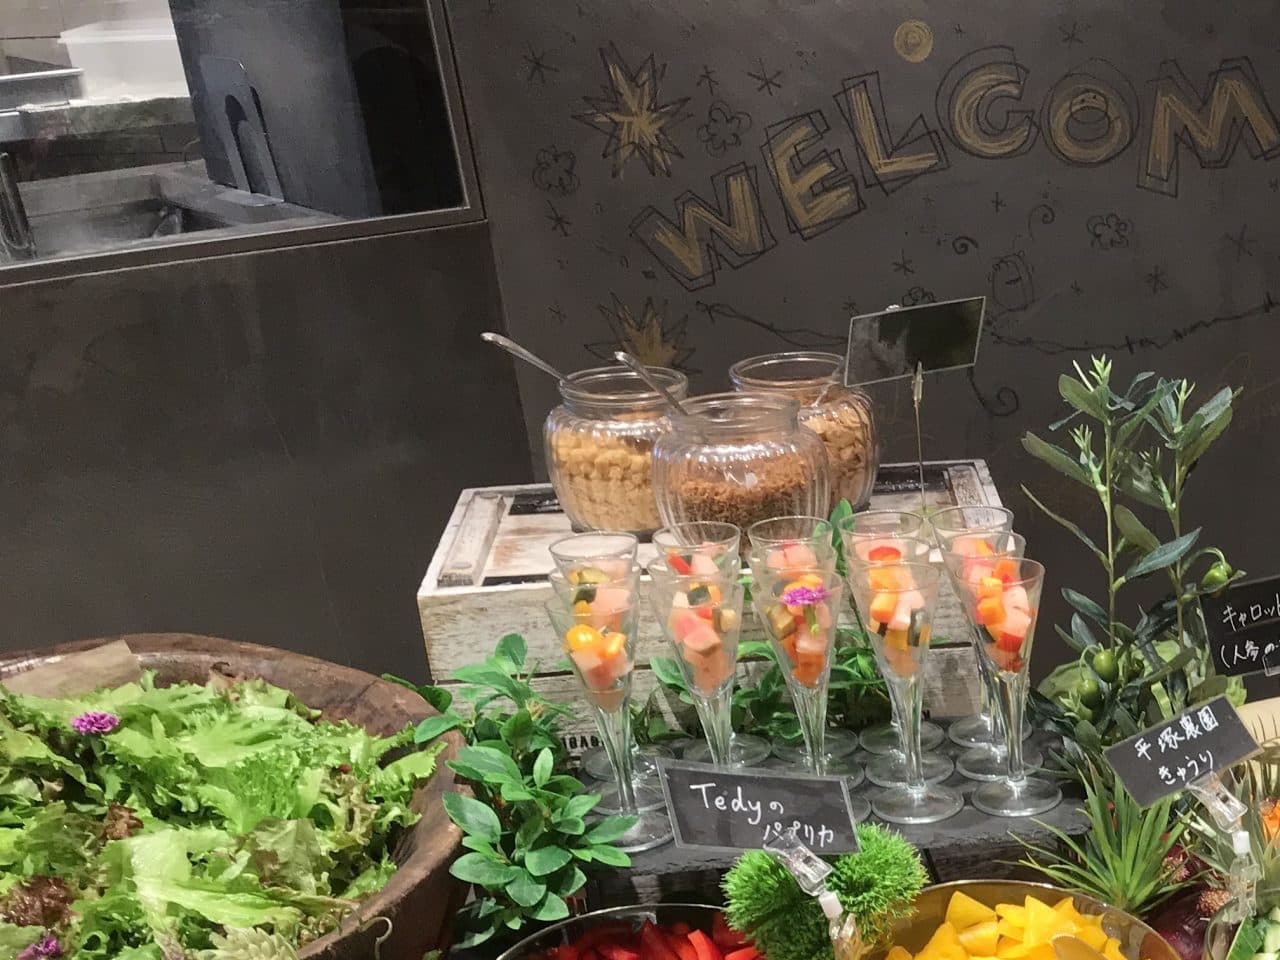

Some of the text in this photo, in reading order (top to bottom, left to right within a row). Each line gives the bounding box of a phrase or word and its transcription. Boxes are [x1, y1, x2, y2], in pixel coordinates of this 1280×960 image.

[1158, 749, 1214, 786] きゅうり
[762, 820, 834, 848] パプリカ
